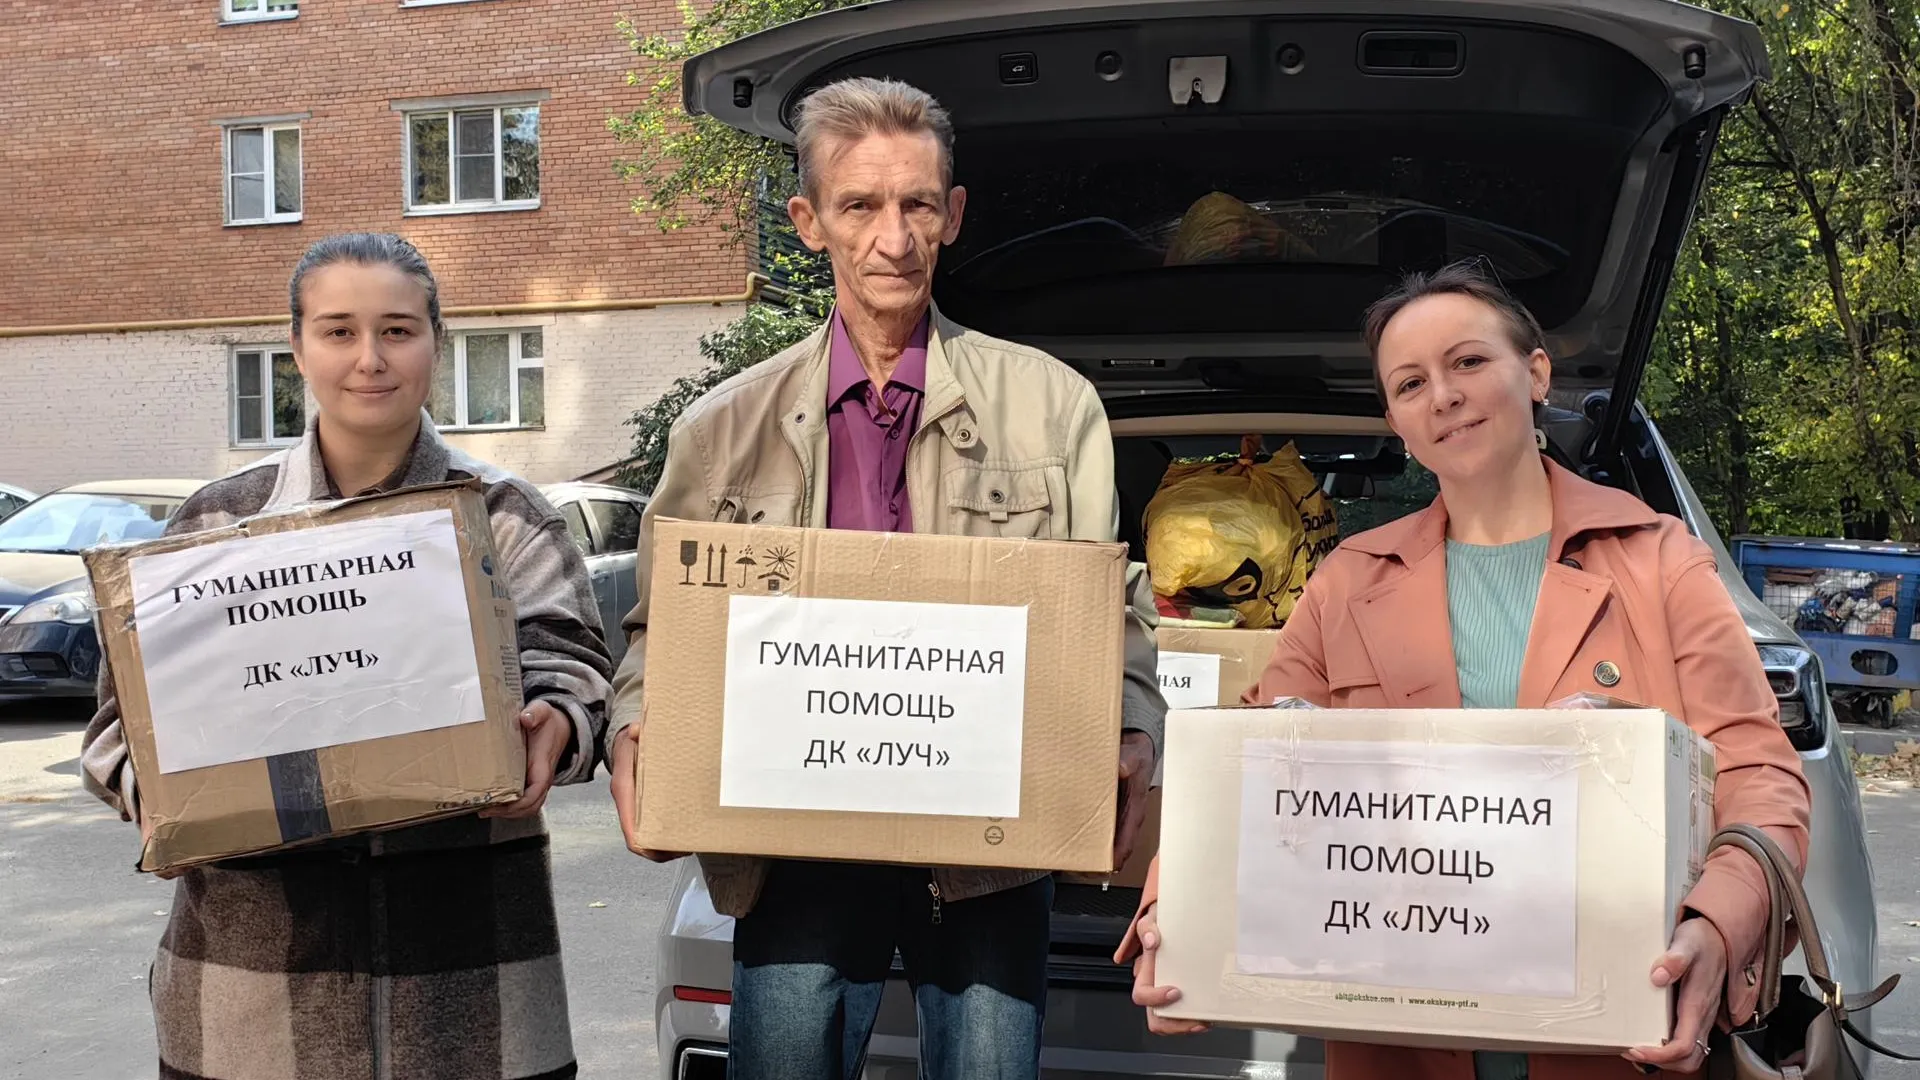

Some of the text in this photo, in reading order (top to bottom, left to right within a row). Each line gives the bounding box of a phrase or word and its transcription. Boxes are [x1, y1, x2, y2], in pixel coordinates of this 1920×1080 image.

[172, 550, 416, 604] ГУМАНИТАРНАЯ
[225, 588, 367, 626] ПОМОЩЬ
[244, 649, 379, 691] ДК «ЛУЧ»
[759, 640, 1004, 675] ГУМАНИТАРНАЯ
[806, 689, 955, 721] ПОМОЩЬ
[803, 739, 950, 769] ДК «ЛУЧ»
[1275, 789, 1552, 826] ГУМАНИТАРНАЯ
[1326, 844, 1495, 884] ПОМОЩЬ
[1324, 900, 1491, 935] ДК «ЛУЧ»
